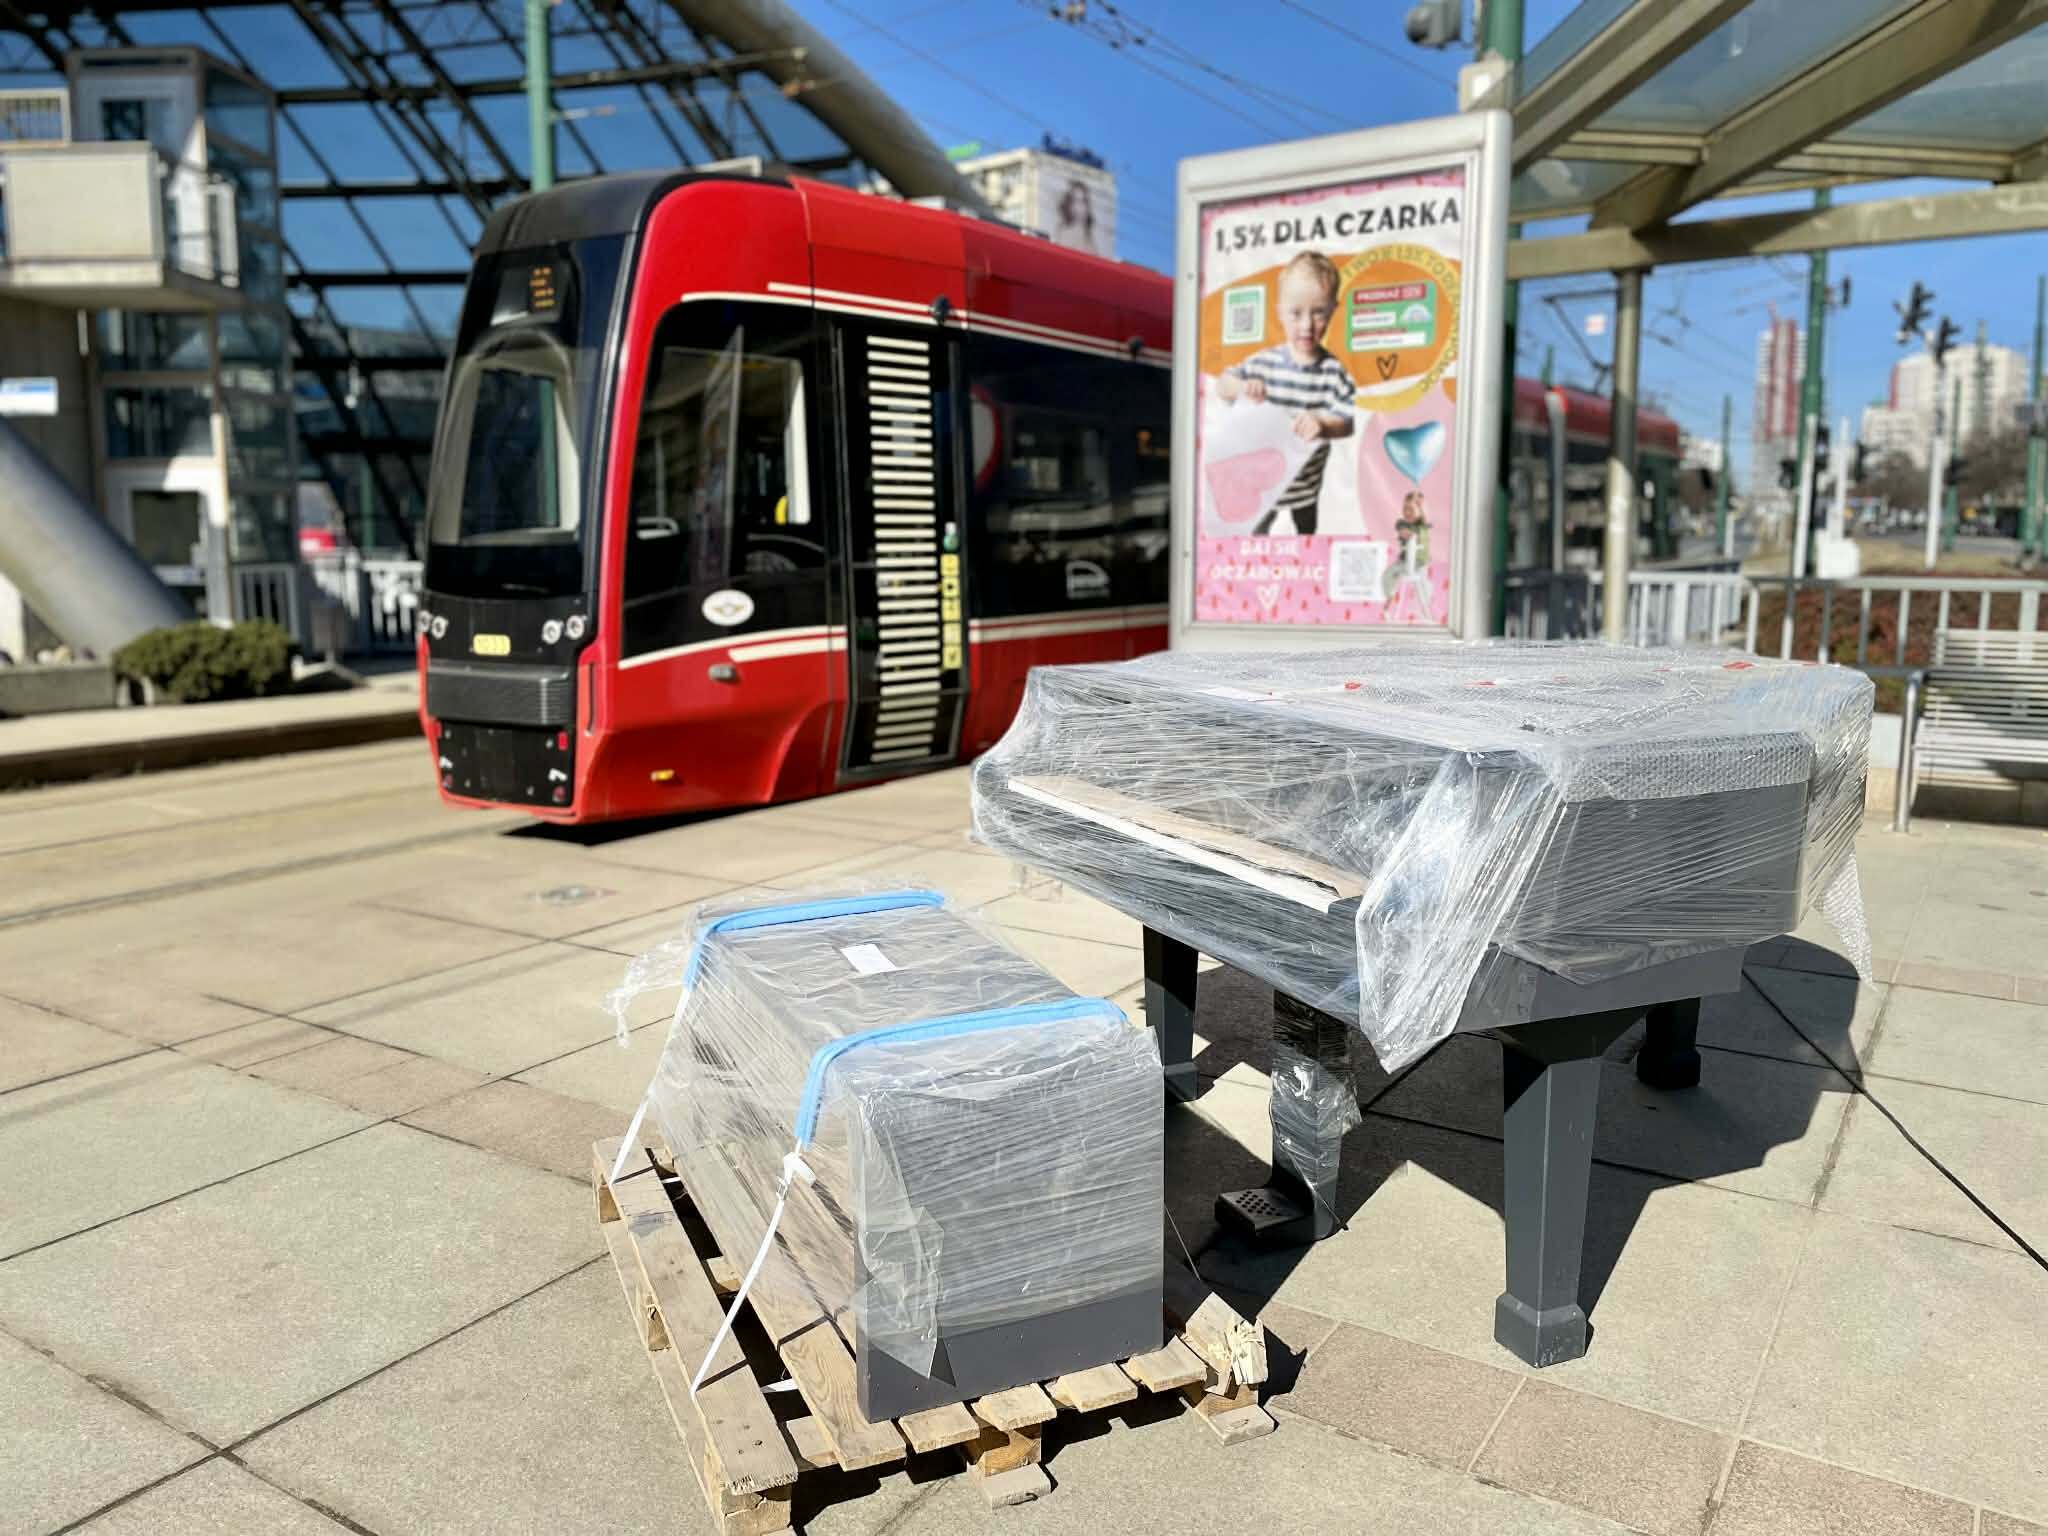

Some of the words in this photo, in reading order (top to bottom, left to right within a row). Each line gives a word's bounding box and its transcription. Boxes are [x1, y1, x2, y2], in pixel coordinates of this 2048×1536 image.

[1216, 222, 1266, 255] 1,5%
[1274, 216, 1327, 244] DLA
[1334, 197, 1460, 236] CZARKA
